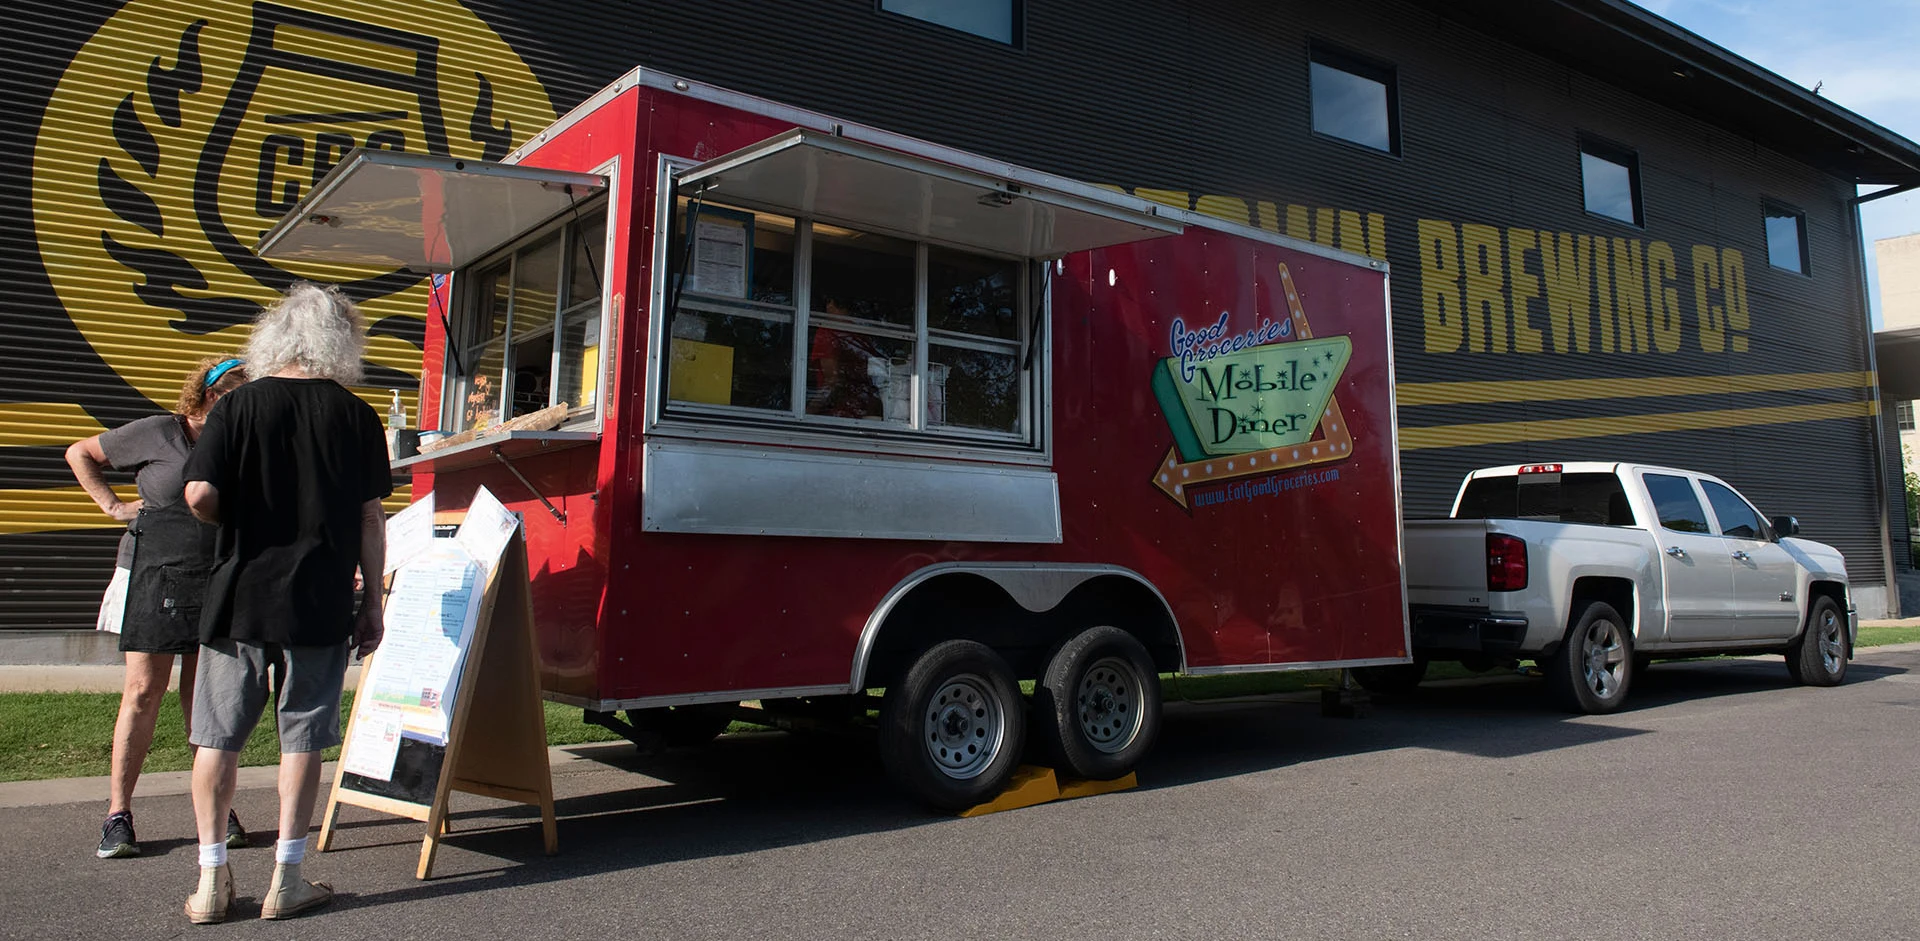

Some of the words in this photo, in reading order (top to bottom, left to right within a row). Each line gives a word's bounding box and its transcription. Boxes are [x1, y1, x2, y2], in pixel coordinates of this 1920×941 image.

[1417, 218, 1685, 354] BREWING
[1691, 244, 1750, 354] CO
[1170, 312, 1228, 357] Good
[1180, 317, 1292, 384] Groceries
[1196, 361, 1316, 402] Mobile
[1207, 407, 1307, 445] Diner
[1194, 467, 1340, 507] www.EatGoodGroceries.com
